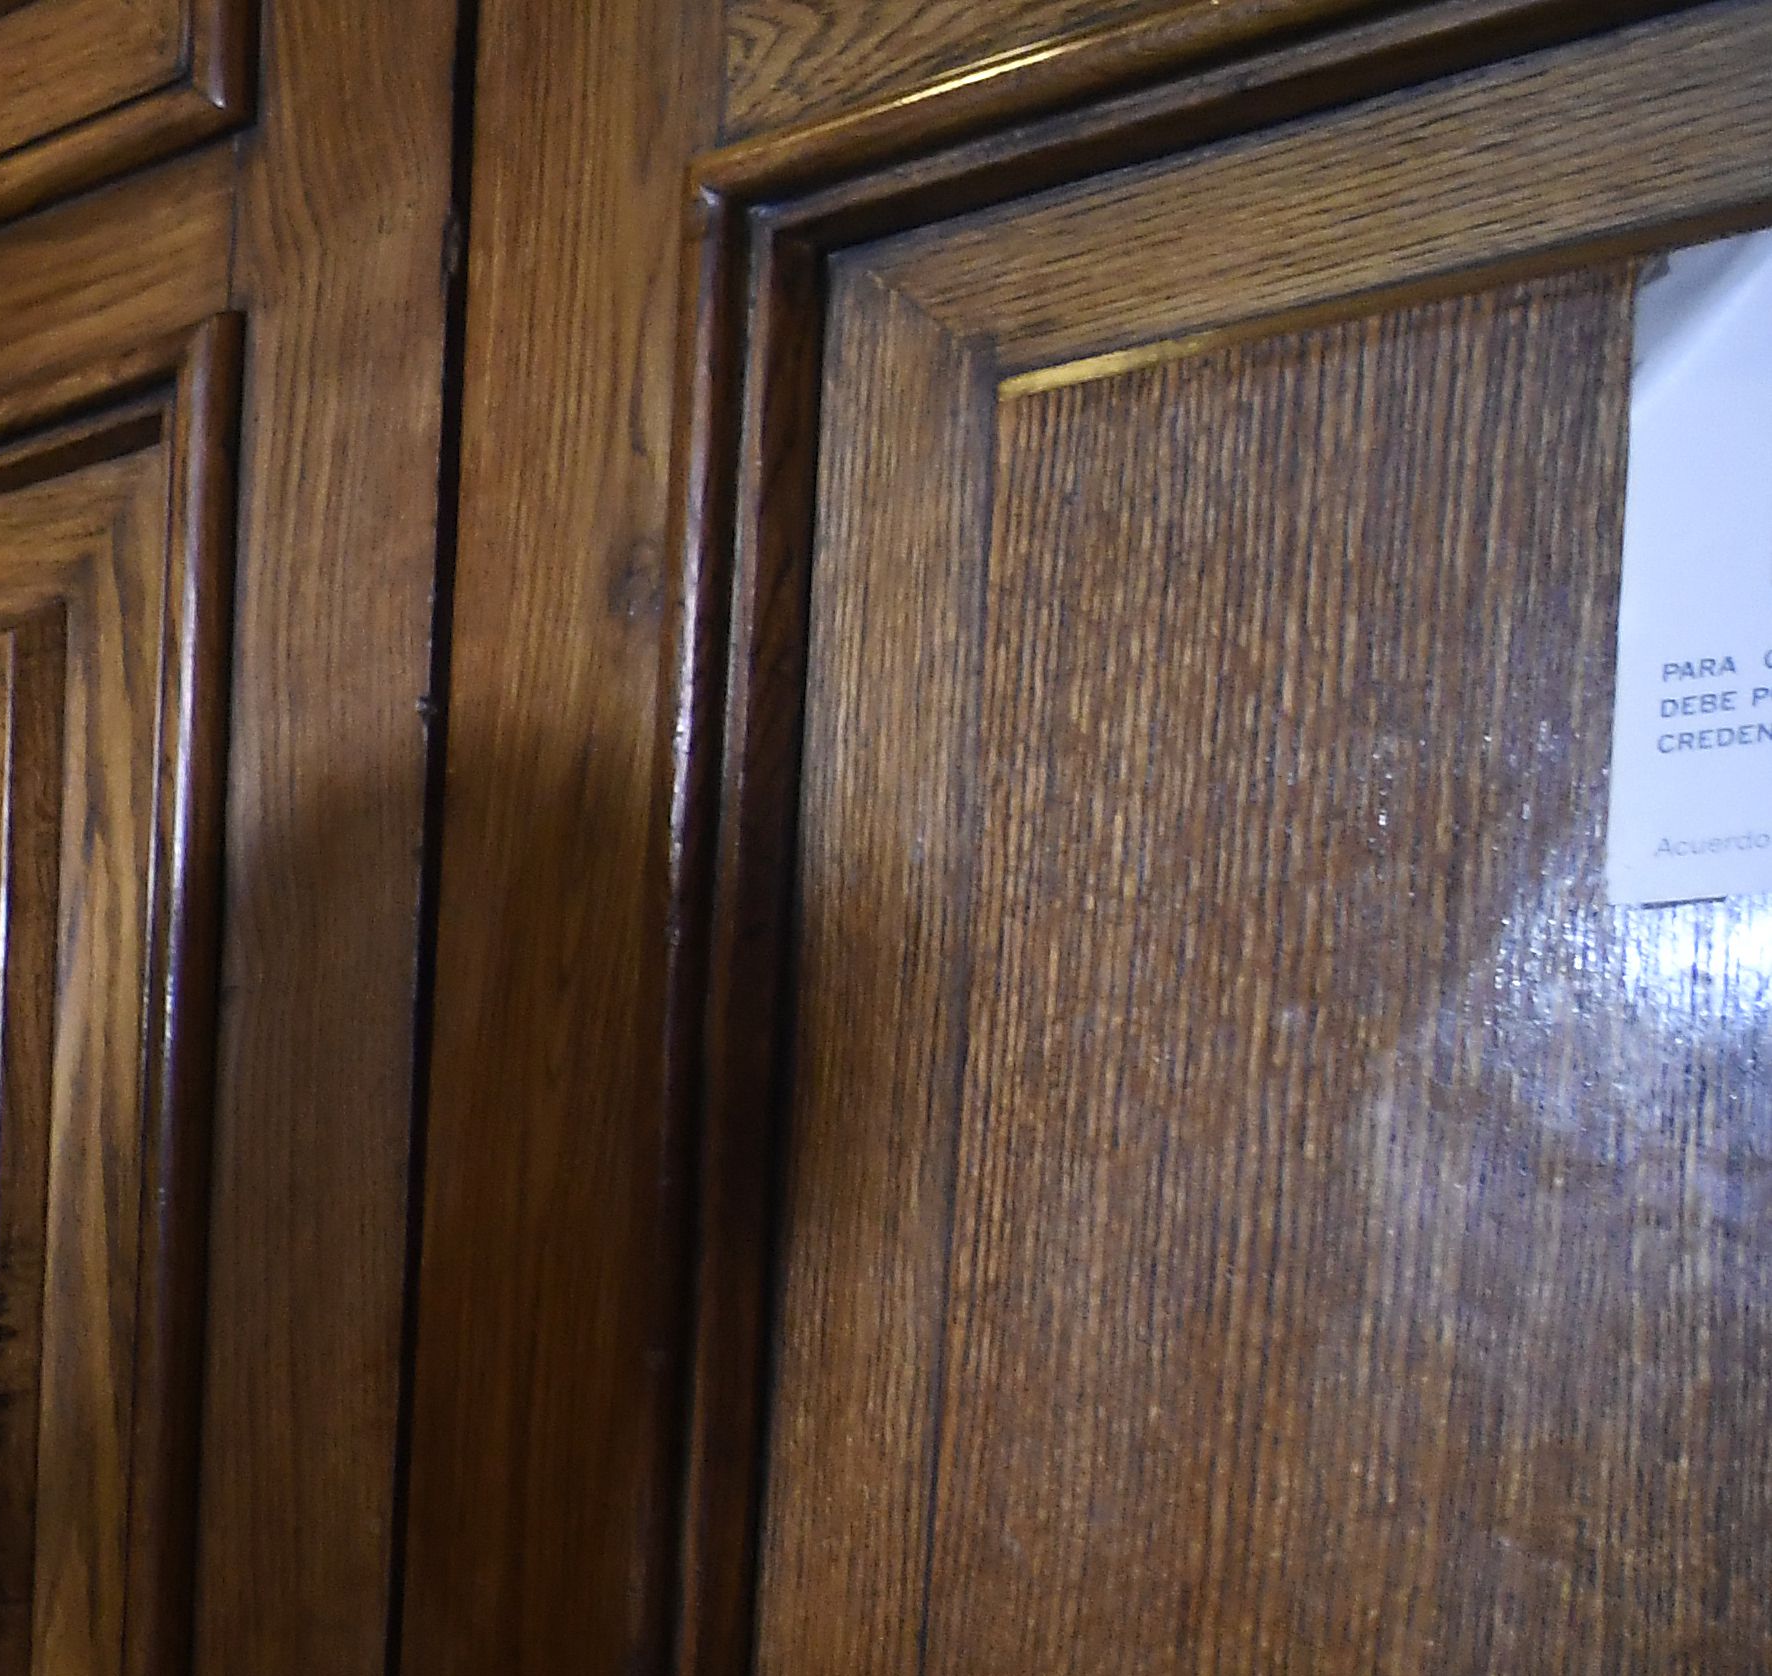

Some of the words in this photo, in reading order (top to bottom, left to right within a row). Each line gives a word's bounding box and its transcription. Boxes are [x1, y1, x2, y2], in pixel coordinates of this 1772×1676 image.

[1662, 656, 1736, 682] PARA
[1660, 691, 1737, 718] DEBE
[1655, 832, 1770, 856] Acuerdo
